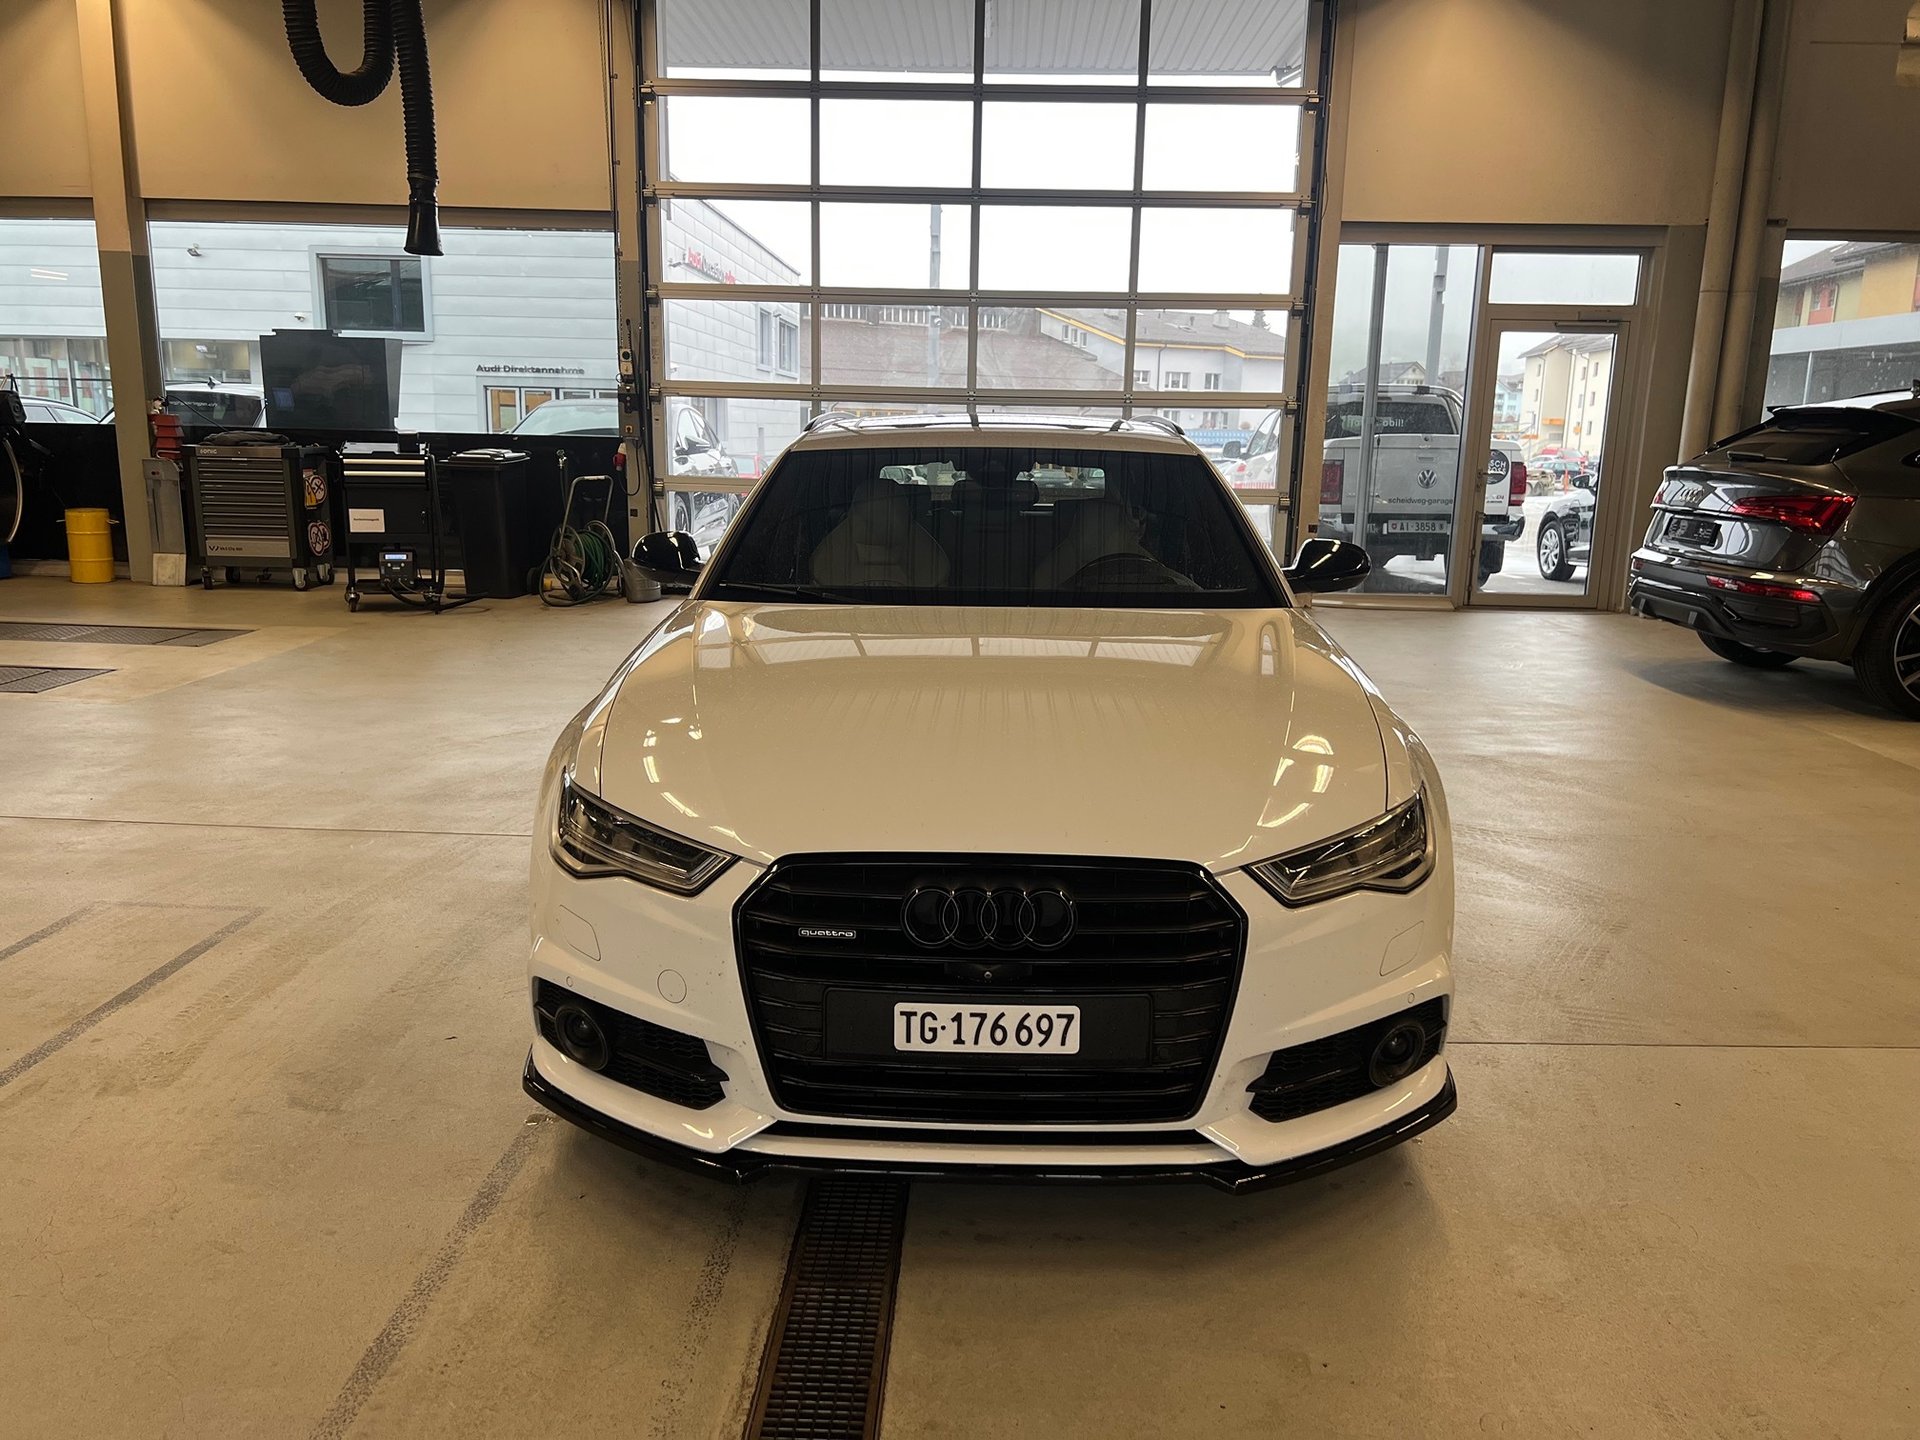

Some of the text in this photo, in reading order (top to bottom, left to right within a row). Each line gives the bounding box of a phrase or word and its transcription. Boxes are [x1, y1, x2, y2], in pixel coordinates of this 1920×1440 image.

[476, 364, 585, 375] Audi Direktannahme
[801, 929, 854, 937] quattro
